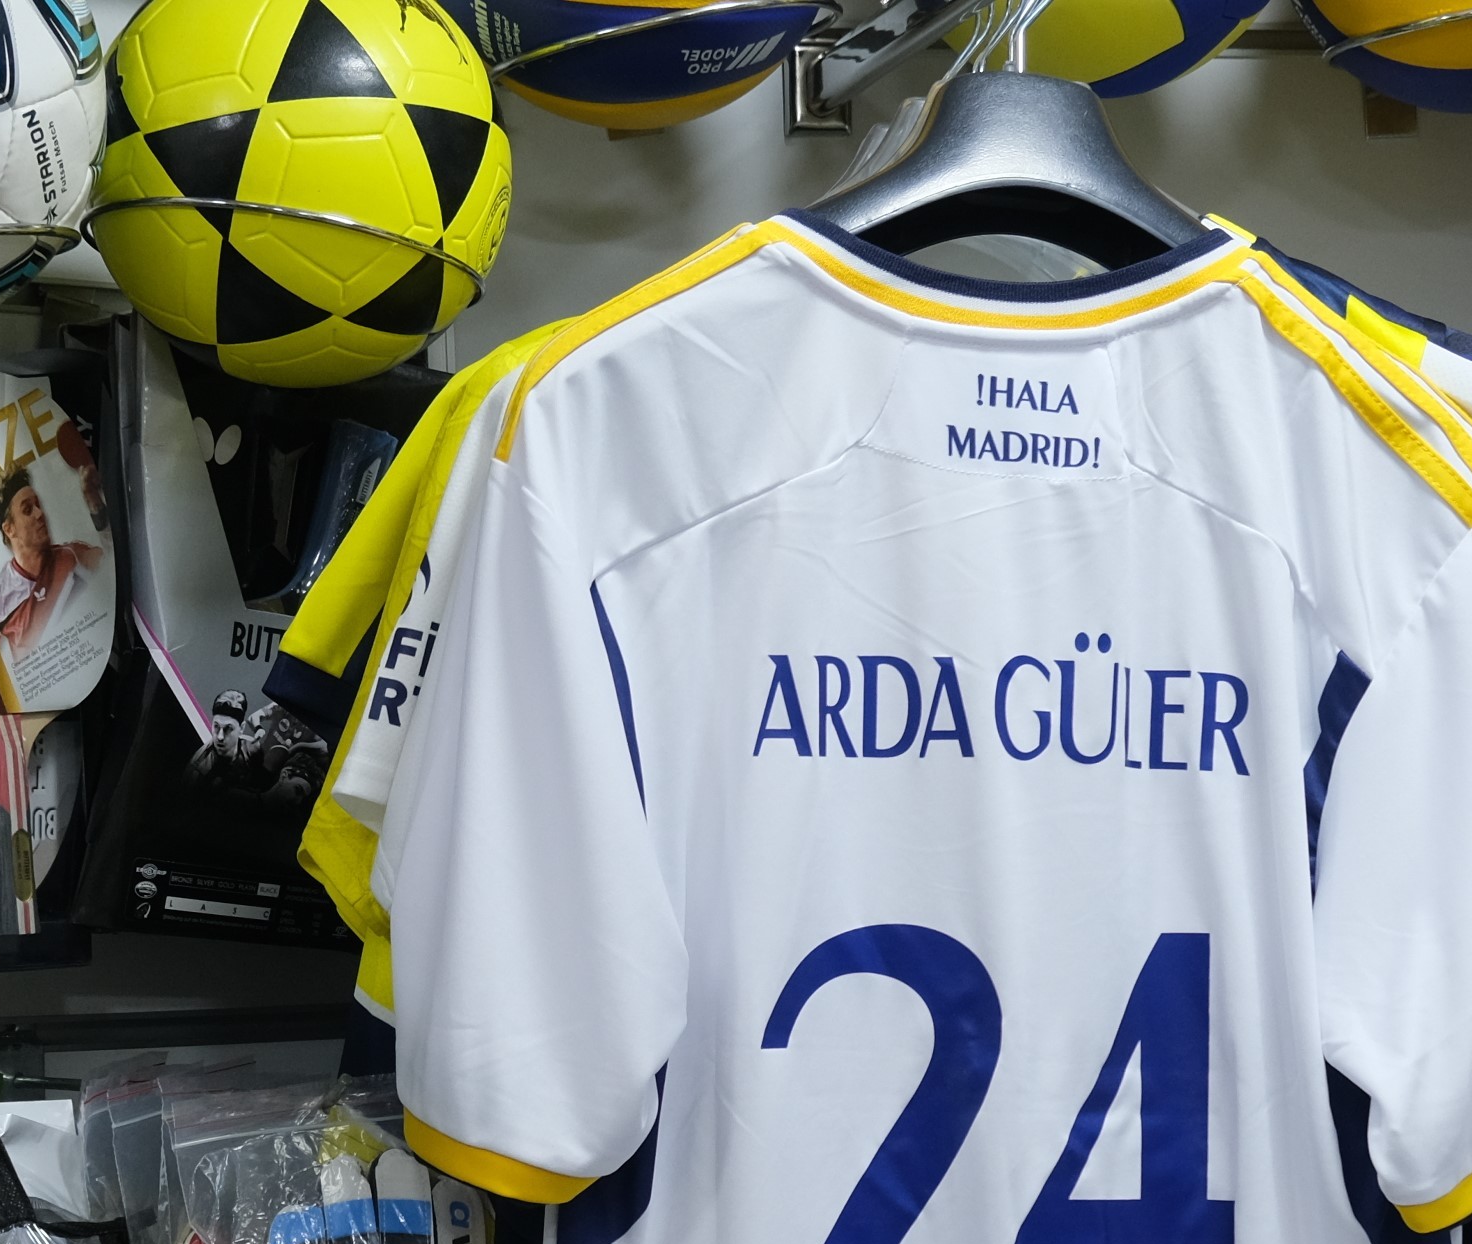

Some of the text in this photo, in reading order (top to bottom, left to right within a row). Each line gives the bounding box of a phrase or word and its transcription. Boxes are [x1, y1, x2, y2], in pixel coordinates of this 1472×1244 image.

[681, 46, 738, 61] MODEL
[687, 62, 722, 74] PRO
[22, 109, 56, 204] STARION
[48, 120, 68, 194] Futsal Match
[977, 374, 1079, 415] !HALA
[946, 424, 1101, 469] MADRID!
[753, 633, 1250, 777] ARDA GÜLER
